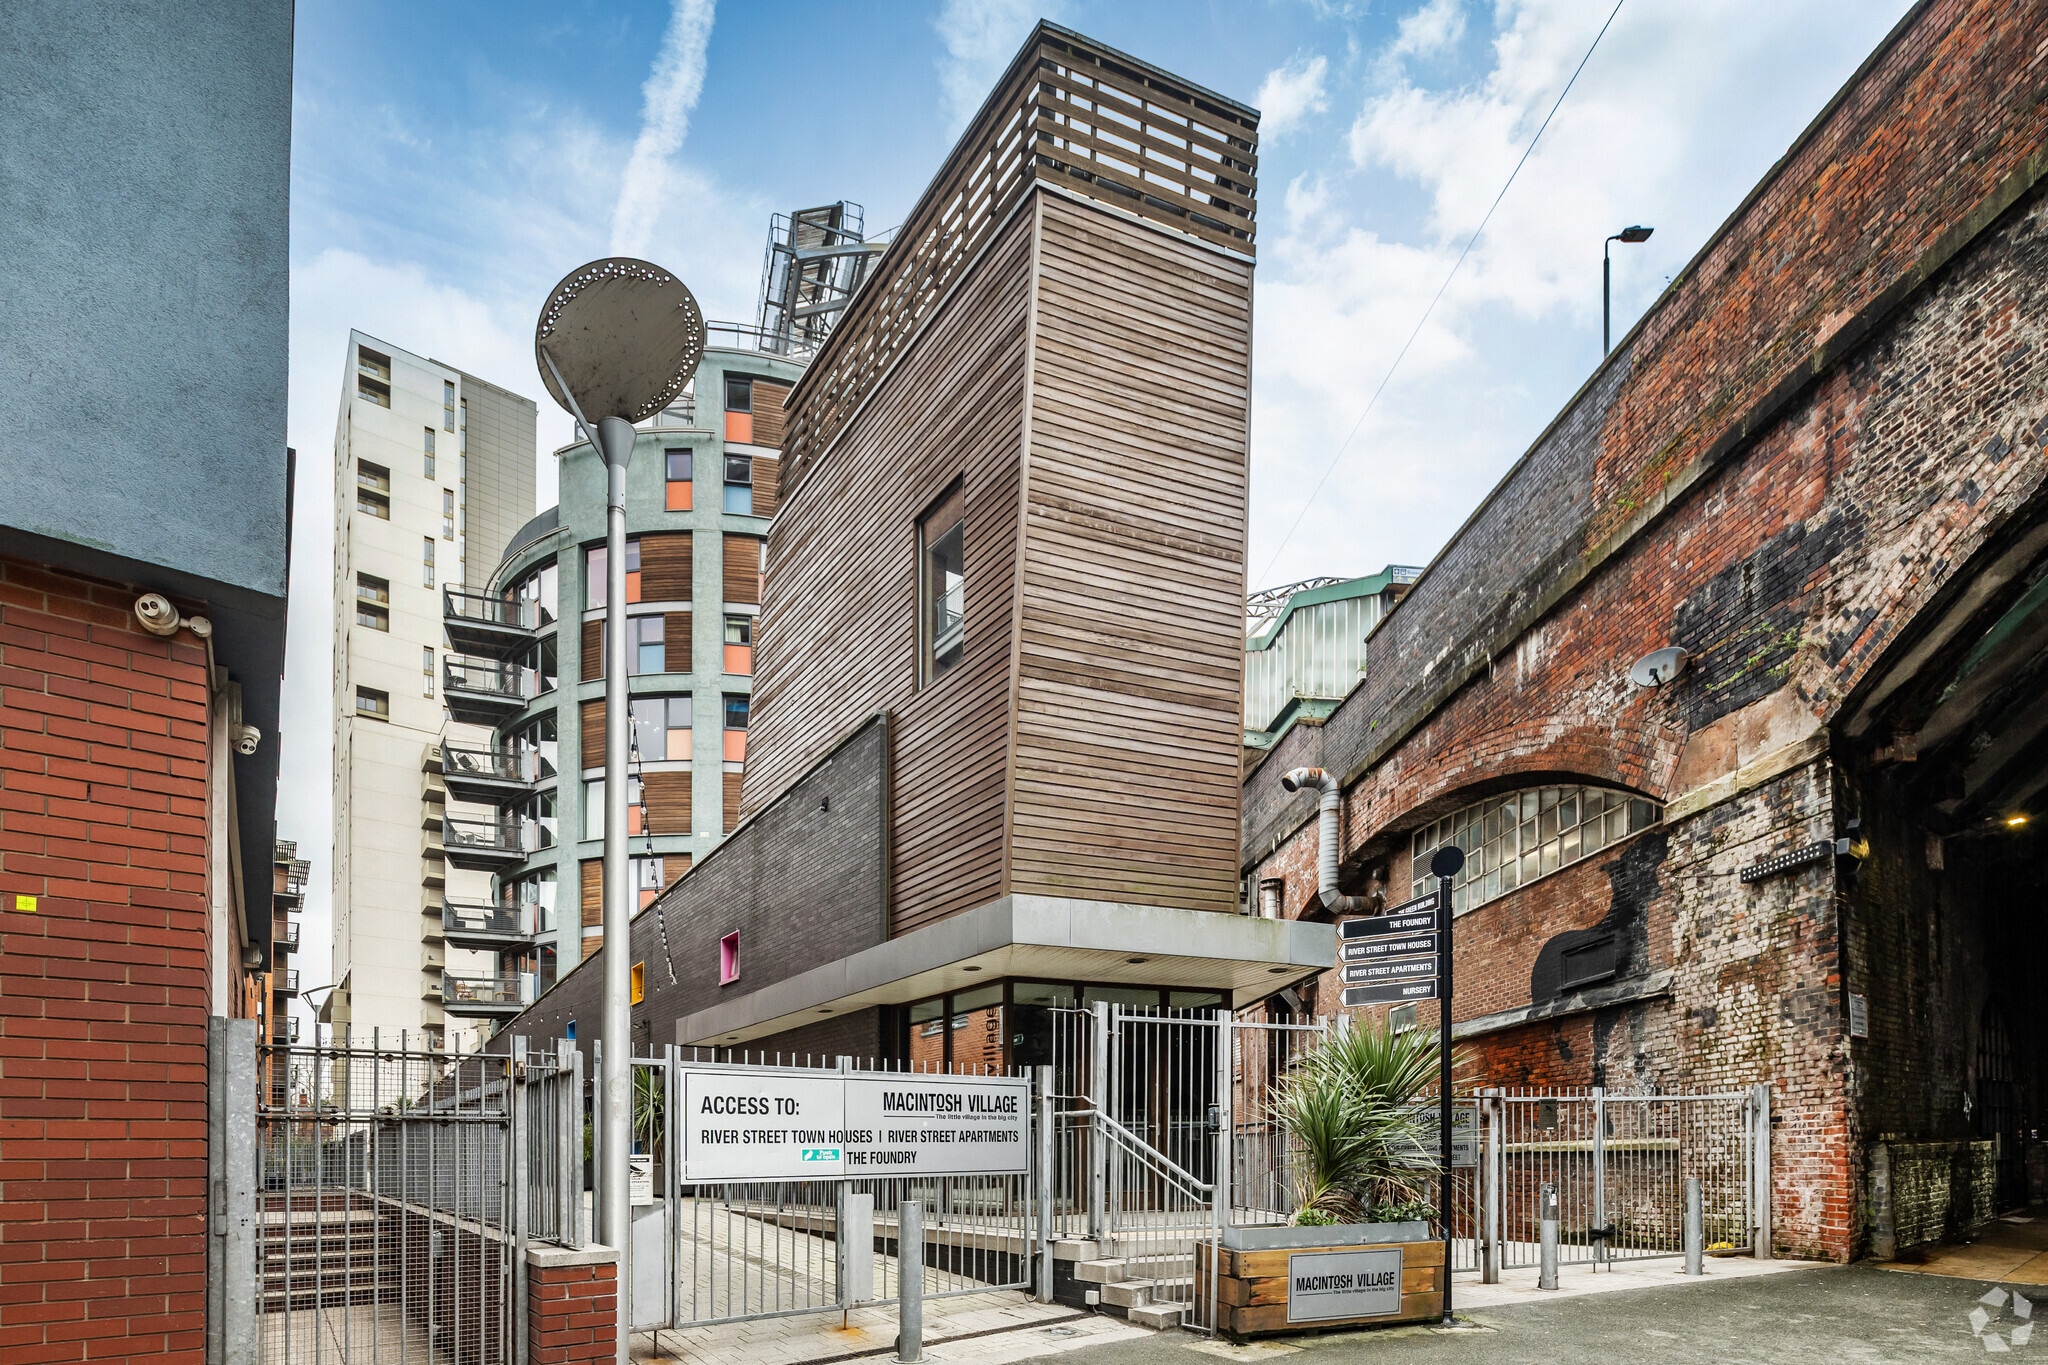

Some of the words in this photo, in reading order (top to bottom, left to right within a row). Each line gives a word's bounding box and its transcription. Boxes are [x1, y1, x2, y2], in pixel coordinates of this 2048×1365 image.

[1402, 916, 1432, 926] FOUNDRY
[1348, 948, 1365, 956] RIVER
[1366, 944, 1388, 953] STREET
[1389, 942, 1406, 950] TOWN
[1408, 940, 1432, 949] HOUSES
[1350, 969, 1367, 977] RIVER
[1368, 967, 1390, 976] STREET
[1391, 963, 1432, 974] APARTMENTS
[1402, 986, 1431, 995] NURSERY
[701, 1096, 770, 1115] ACCESS
[774, 1098, 800, 1116] TO:
[883, 1092, 962, 1112] MACINTOSH
[968, 1094, 1018, 1113] VILLAGE
[701, 1130, 739, 1144] RIVER
[743, 1130, 788, 1144] STREET
[792, 1130, 825, 1144] TOWN
[828, 1130, 872, 1143] HOUSES
[888, 1130, 917, 1143] RIVER
[920, 1130, 956, 1143] STREET
[958, 1130, 1019, 1143] APARTMENTS
[847, 1152, 867, 1164] THE
[870, 1151, 917, 1164] FOUNDRY
[1296, 1274, 1353, 1291] MACINTOSH
[1357, 1272, 1395, 1287] VILLAGE
